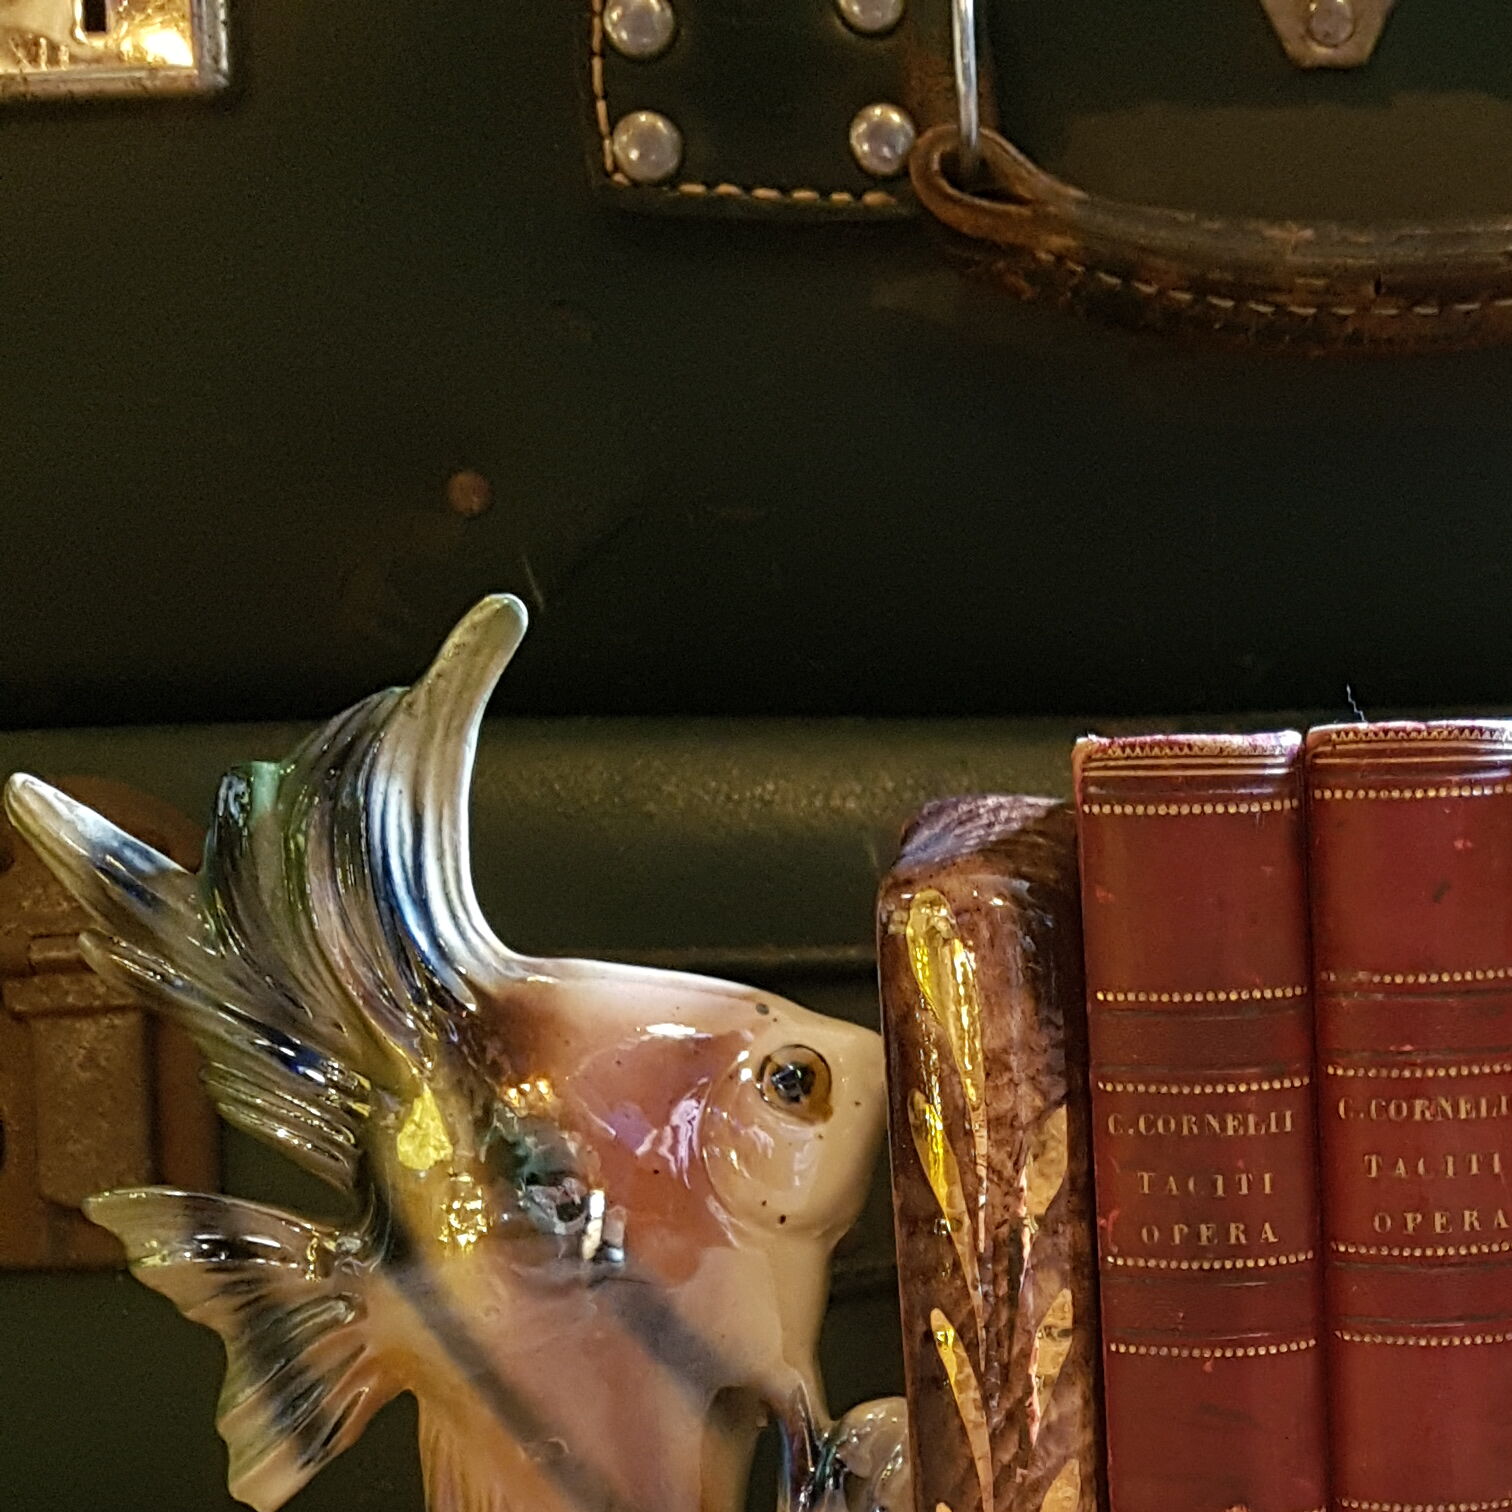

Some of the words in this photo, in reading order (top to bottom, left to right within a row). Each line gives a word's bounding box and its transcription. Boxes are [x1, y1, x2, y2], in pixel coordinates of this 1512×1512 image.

[1137, 1171, 1273, 1197] TACITI
[1141, 1222, 1279, 1246] OPERA
[1373, 1209, 1511, 1234] OPERA
